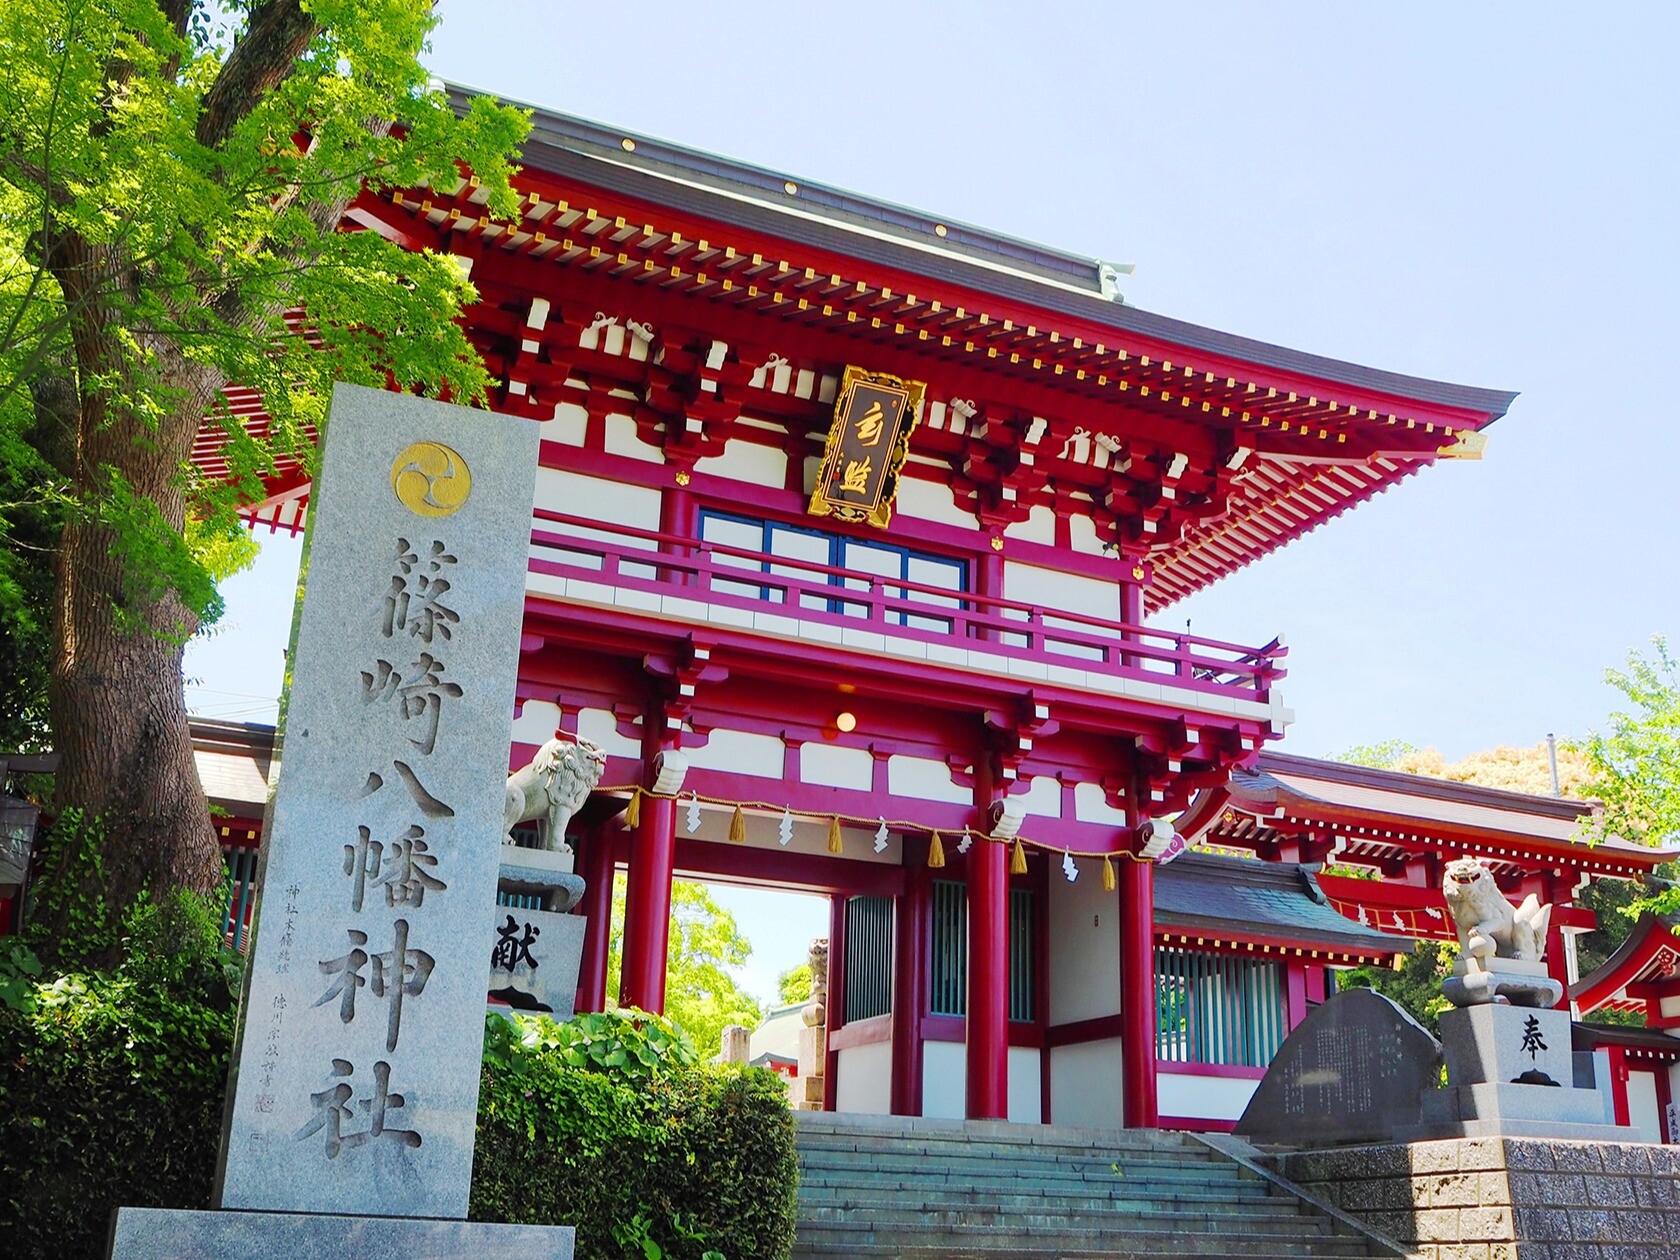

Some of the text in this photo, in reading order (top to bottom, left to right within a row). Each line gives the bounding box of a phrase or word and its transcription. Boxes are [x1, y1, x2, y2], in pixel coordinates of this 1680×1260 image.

[299, 538, 463, 1160] 篠崎八幡神社
[491, 914, 540, 972] 献
[1520, 1013, 1548, 1061] 奉
